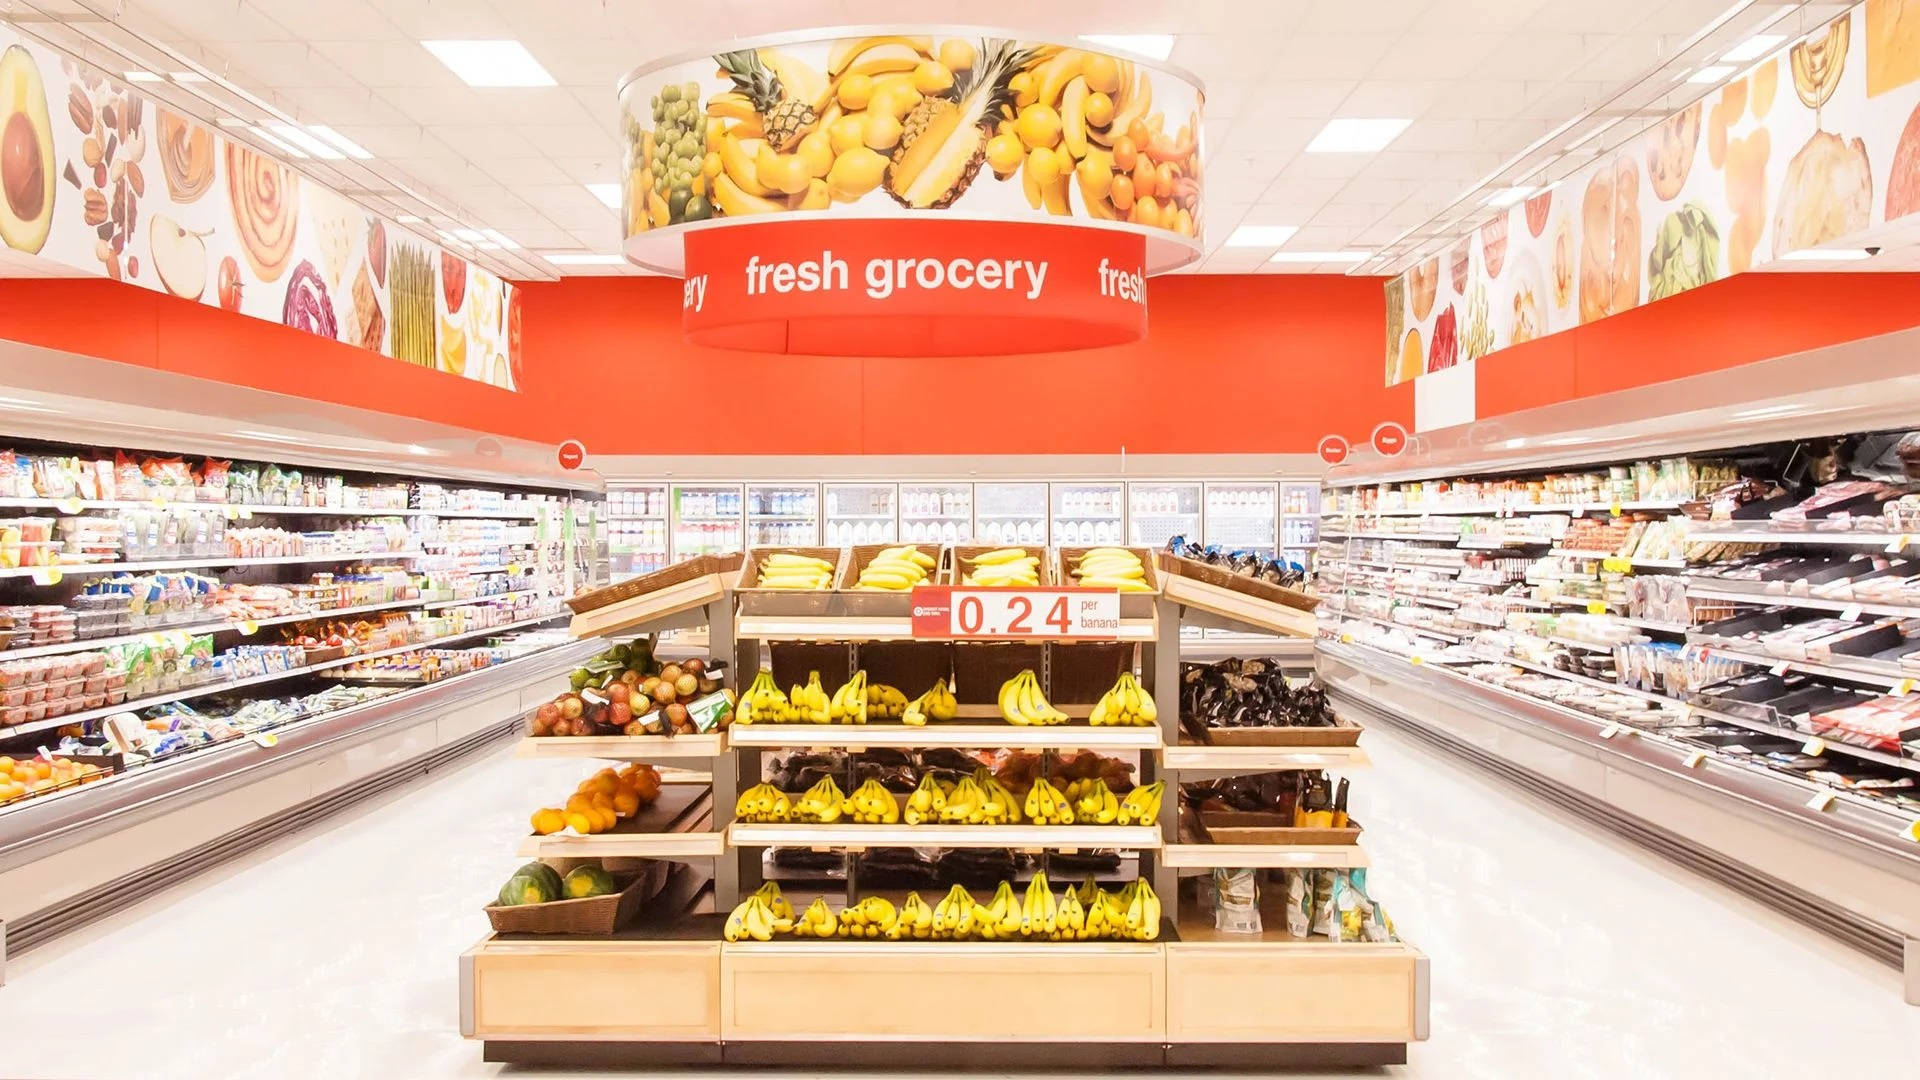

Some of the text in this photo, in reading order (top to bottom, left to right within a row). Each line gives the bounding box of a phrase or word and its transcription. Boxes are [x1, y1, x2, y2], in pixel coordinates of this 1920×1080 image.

[746, 250, 1048, 300] fresh grocery
[1098, 257, 1145, 305] fresh
[958, 596, 1072, 634] 0.24
[1080, 600, 1098, 613] per
[1080, 616, 1118, 628] banana
